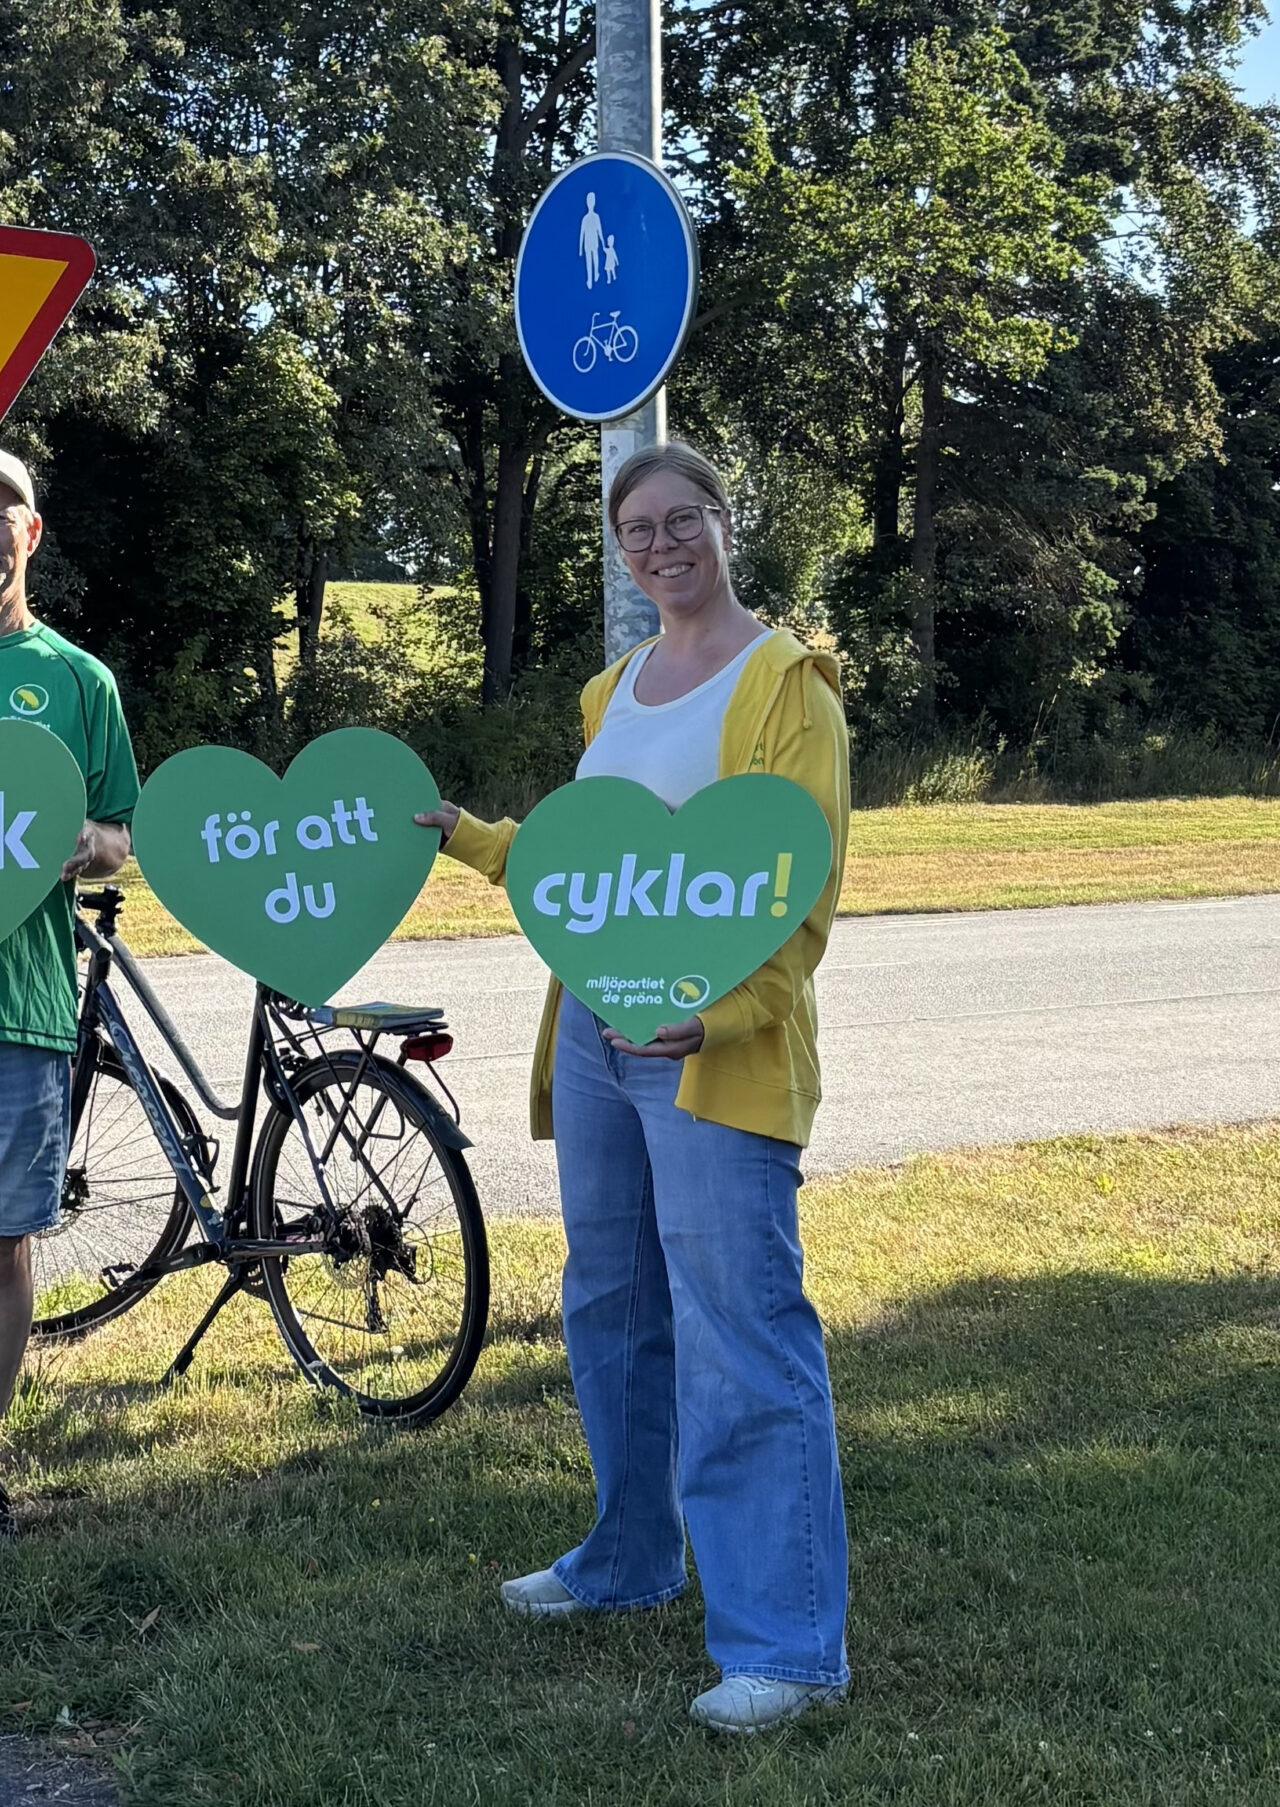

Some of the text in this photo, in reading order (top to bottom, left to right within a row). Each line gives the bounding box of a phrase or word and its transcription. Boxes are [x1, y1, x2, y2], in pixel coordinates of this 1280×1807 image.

[200, 797, 379, 863] för att
[265, 872, 336, 924] du
[532, 852, 793, 934] cyklar!
[586, 975, 665, 992] miljöpartiet
[601, 991, 663, 1008] de gröna
[109, 1020, 195, 1181] Crescent
